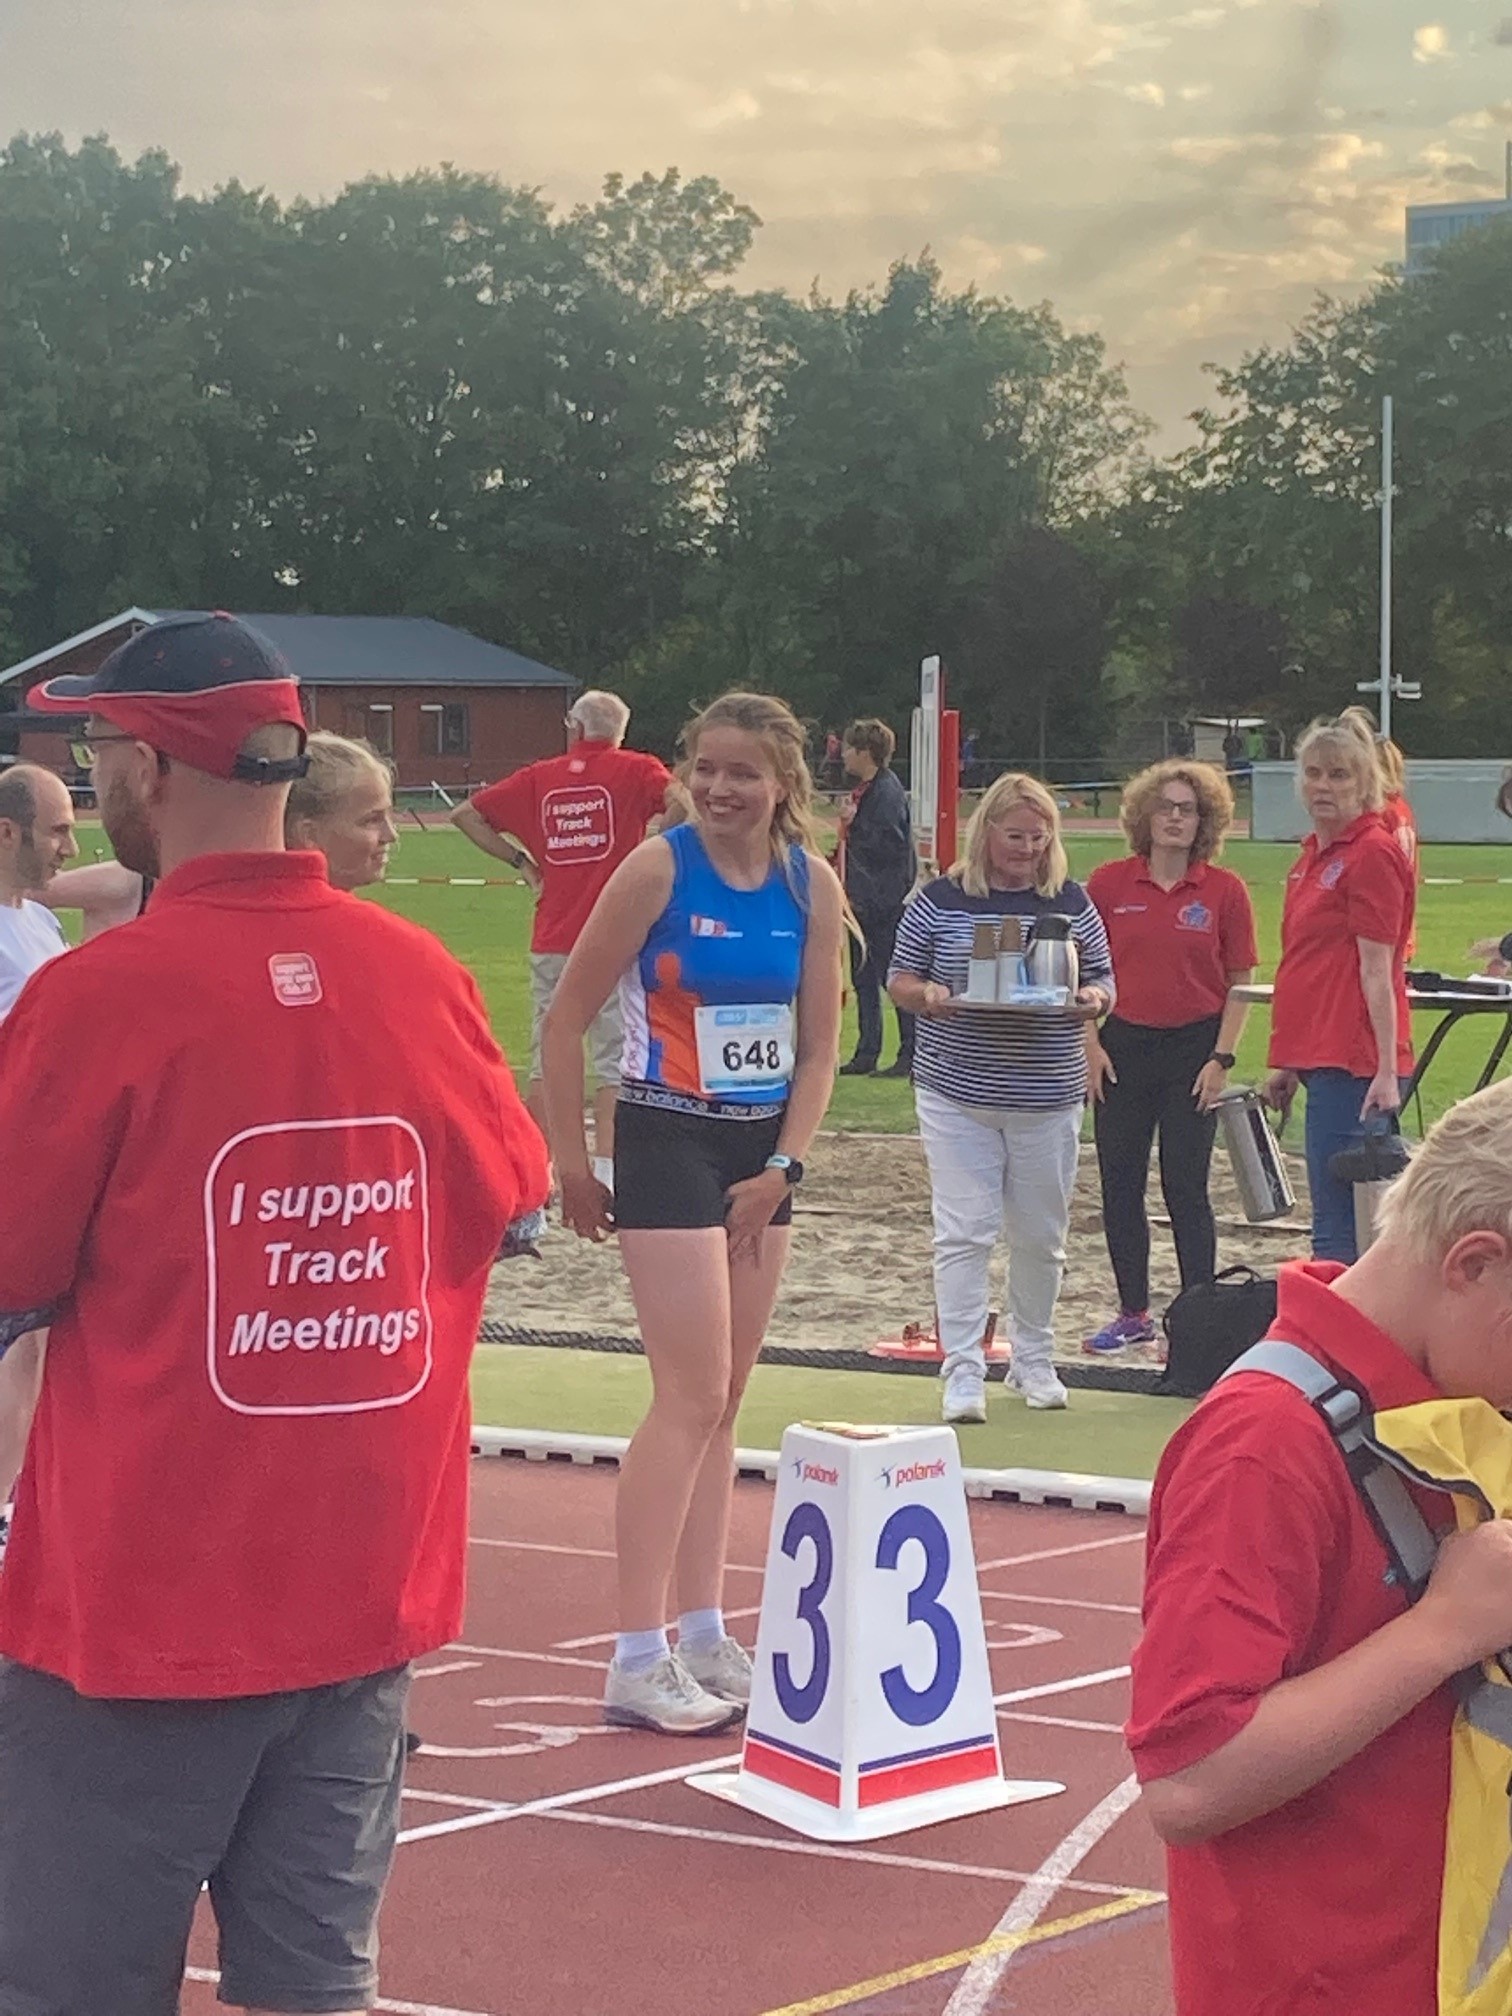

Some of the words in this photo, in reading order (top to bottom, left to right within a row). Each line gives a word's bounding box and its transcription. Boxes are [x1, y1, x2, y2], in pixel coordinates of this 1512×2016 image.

[723, 1040, 780, 1071] 648
[228, 1182, 246, 1227] I
[257, 1169, 415, 1229] support
[264, 1236, 390, 1286] Track
[228, 1305, 420, 1357] Meetings
[772, 1501, 833, 1724] 3
[875, 1503, 962, 1727] 3
